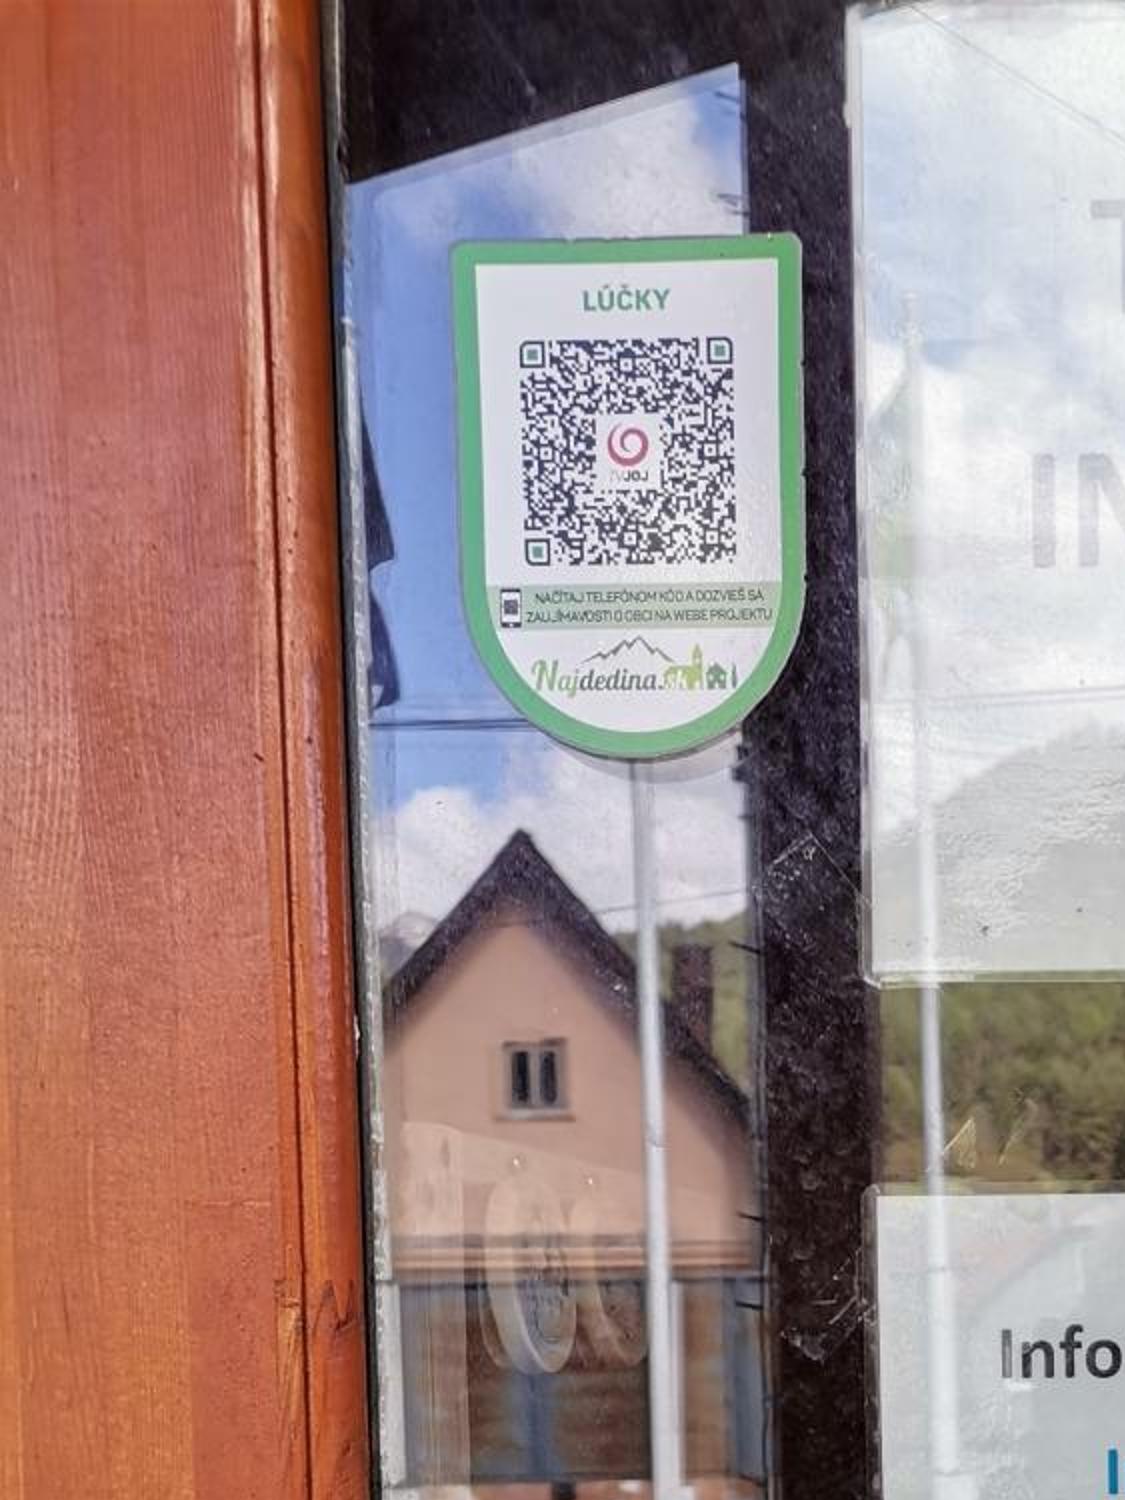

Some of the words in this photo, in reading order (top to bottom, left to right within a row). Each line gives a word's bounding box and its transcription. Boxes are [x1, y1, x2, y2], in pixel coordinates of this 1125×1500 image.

[582, 283, 671, 313] LÚČKY
[535, 588, 583, 604] NAČÍTAJ
[585, 587, 656, 603] TELEFÓNOM
[659, 588, 684, 602] KÓD
[686, 589, 694, 601] A
[696, 586, 744, 602] DOZVIEŠ
[747, 587, 764, 601] SA
[526, 608, 611, 624] ZAUJÍMAVOSTI
[613, 608, 623, 622] O
[625, 608, 653, 622] OBCI
[655, 608, 672, 621] NA
[673, 608, 708, 621] WEBE
[709, 606, 773, 622] PROJEKTU
